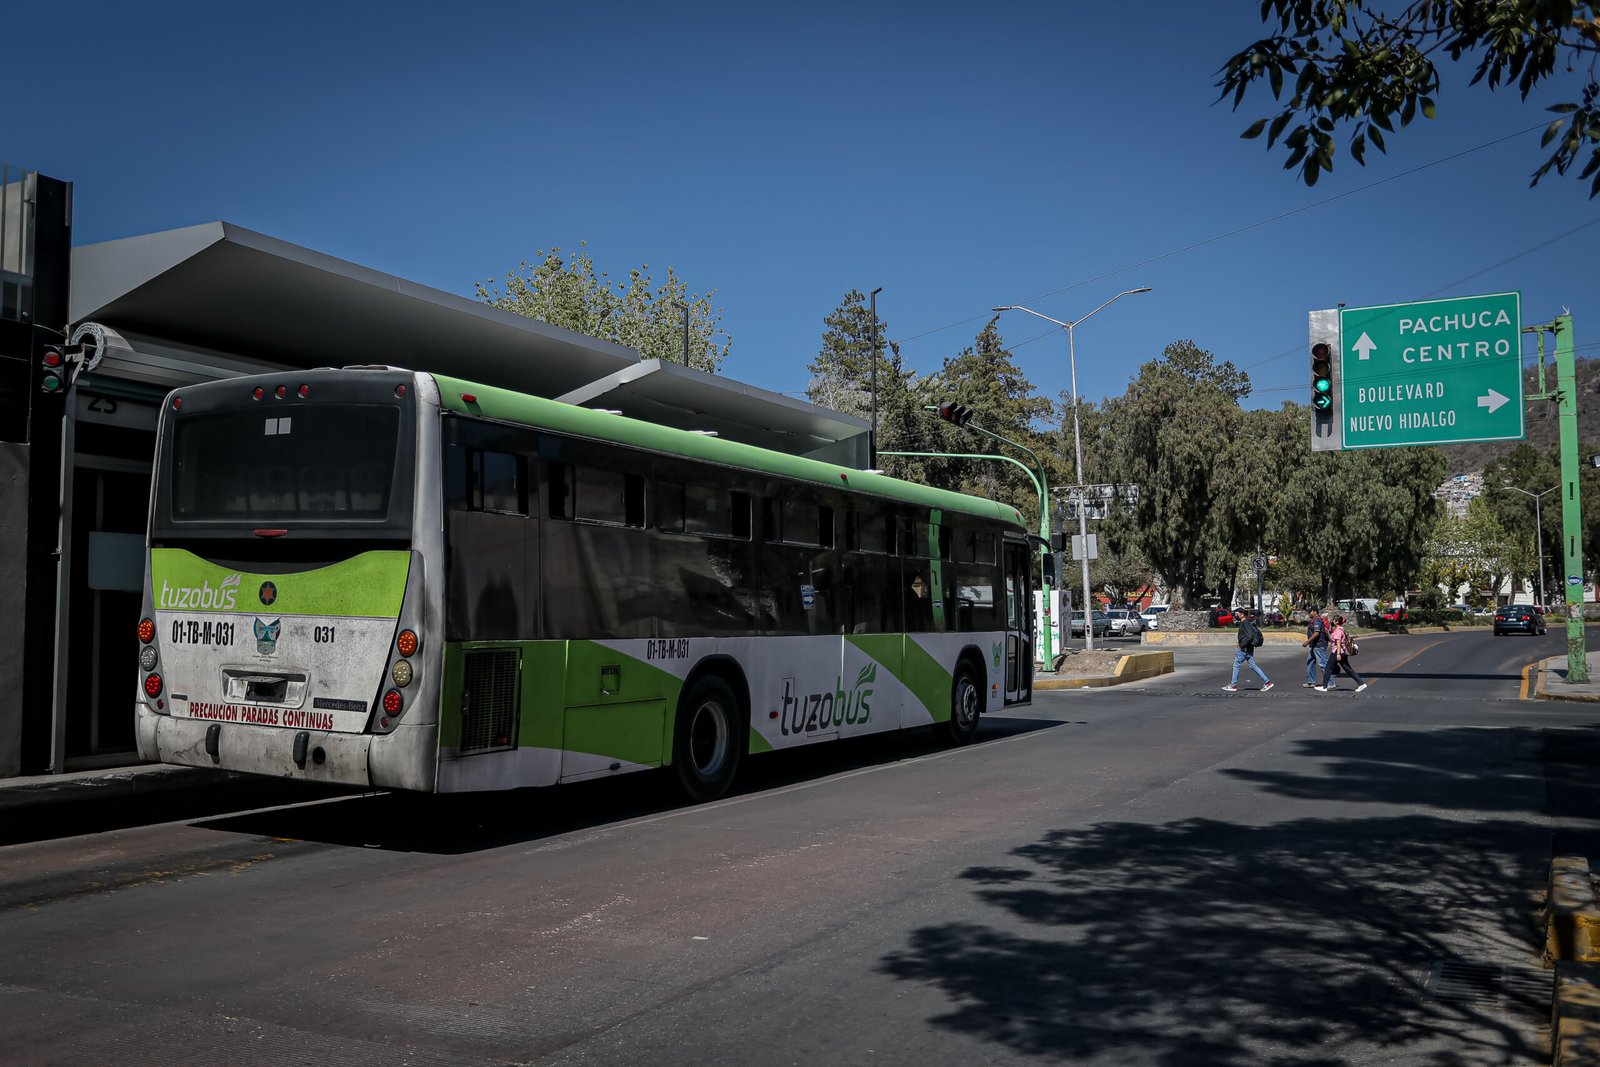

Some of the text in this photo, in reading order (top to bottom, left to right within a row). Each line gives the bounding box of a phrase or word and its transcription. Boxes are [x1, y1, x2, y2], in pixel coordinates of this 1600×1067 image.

[1399, 309, 1511, 335] PACHUCA
[1402, 339, 1510, 363] CENTRO
[1359, 382, 1444, 403] BOULEVARD
[1350, 410, 1456, 432] NUEVO HIDALGO
[172, 620, 235, 646] 01-TB-M-031
[314, 626, 335, 643] 031
[647, 639, 689, 659] 01-TB-M-031
[189, 702, 333, 730] PRECAUCION PARADAS CONTINUAS
[315, 699, 365, 711] Mercedes-Benz
[781, 675, 873, 736] tuzobus
